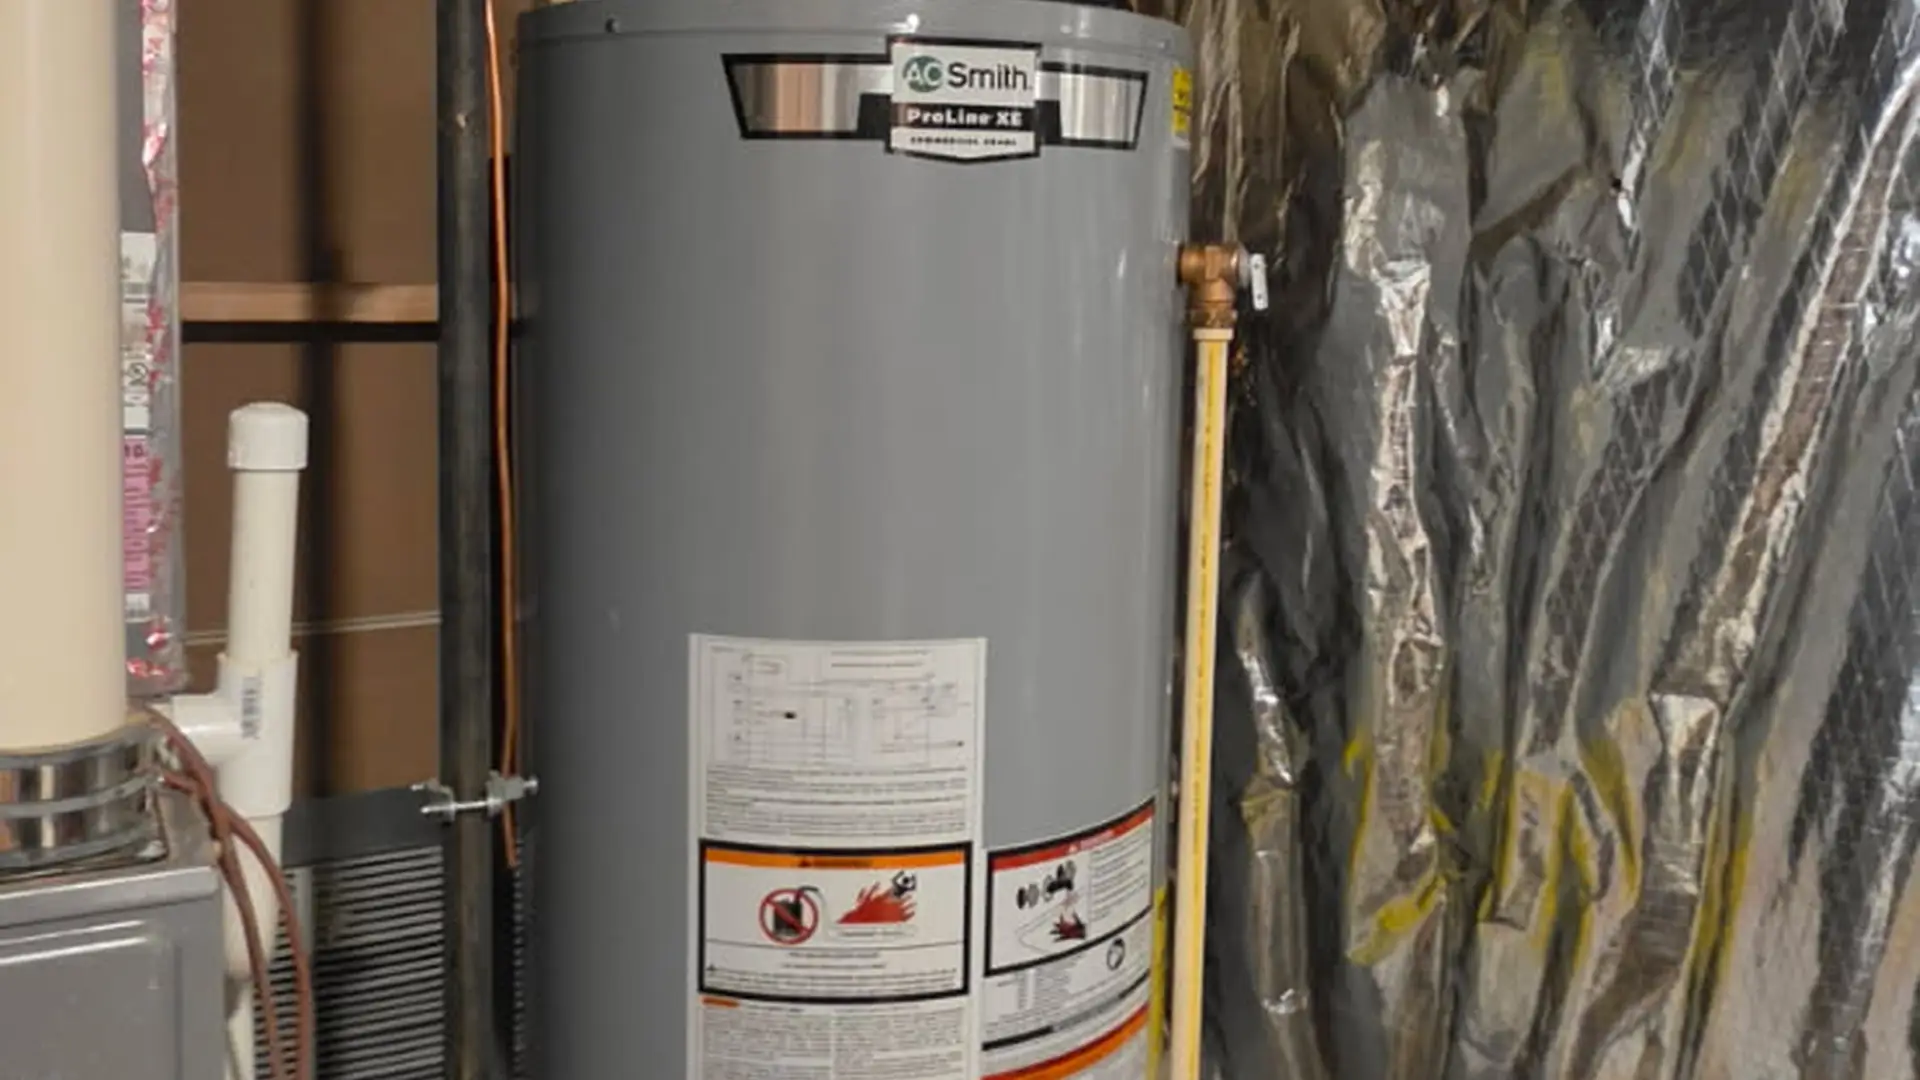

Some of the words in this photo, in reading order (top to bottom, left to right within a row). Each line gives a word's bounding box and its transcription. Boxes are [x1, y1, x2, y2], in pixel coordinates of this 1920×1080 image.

[947, 61, 1028, 90] Smith
[907, 107, 991, 125] ProLine
[995, 110, 1022, 127] XE
